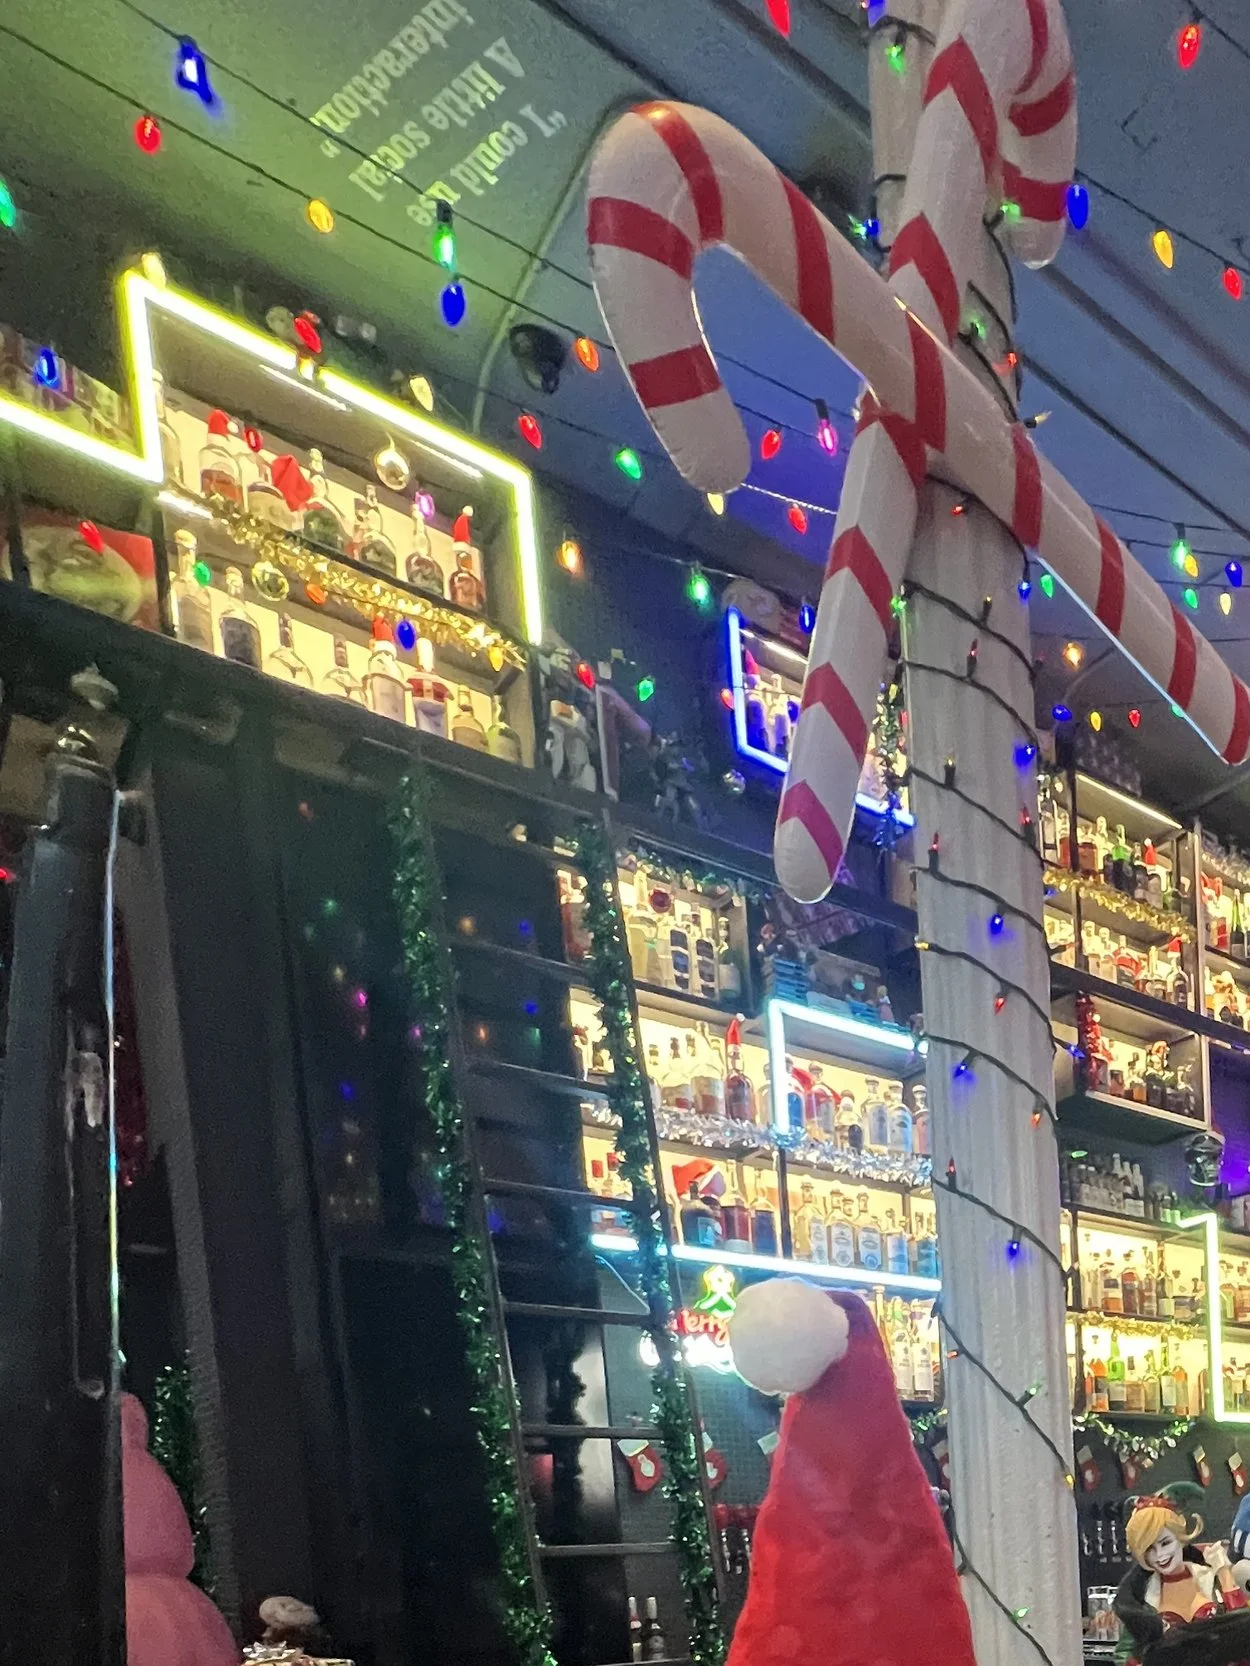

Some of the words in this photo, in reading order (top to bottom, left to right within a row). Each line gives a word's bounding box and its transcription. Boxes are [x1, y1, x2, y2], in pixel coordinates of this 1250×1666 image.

[483, 36, 526, 78] A
[421, 60, 506, 131] little
[348, 120, 431, 202] social
[450, 119, 529, 196] could
